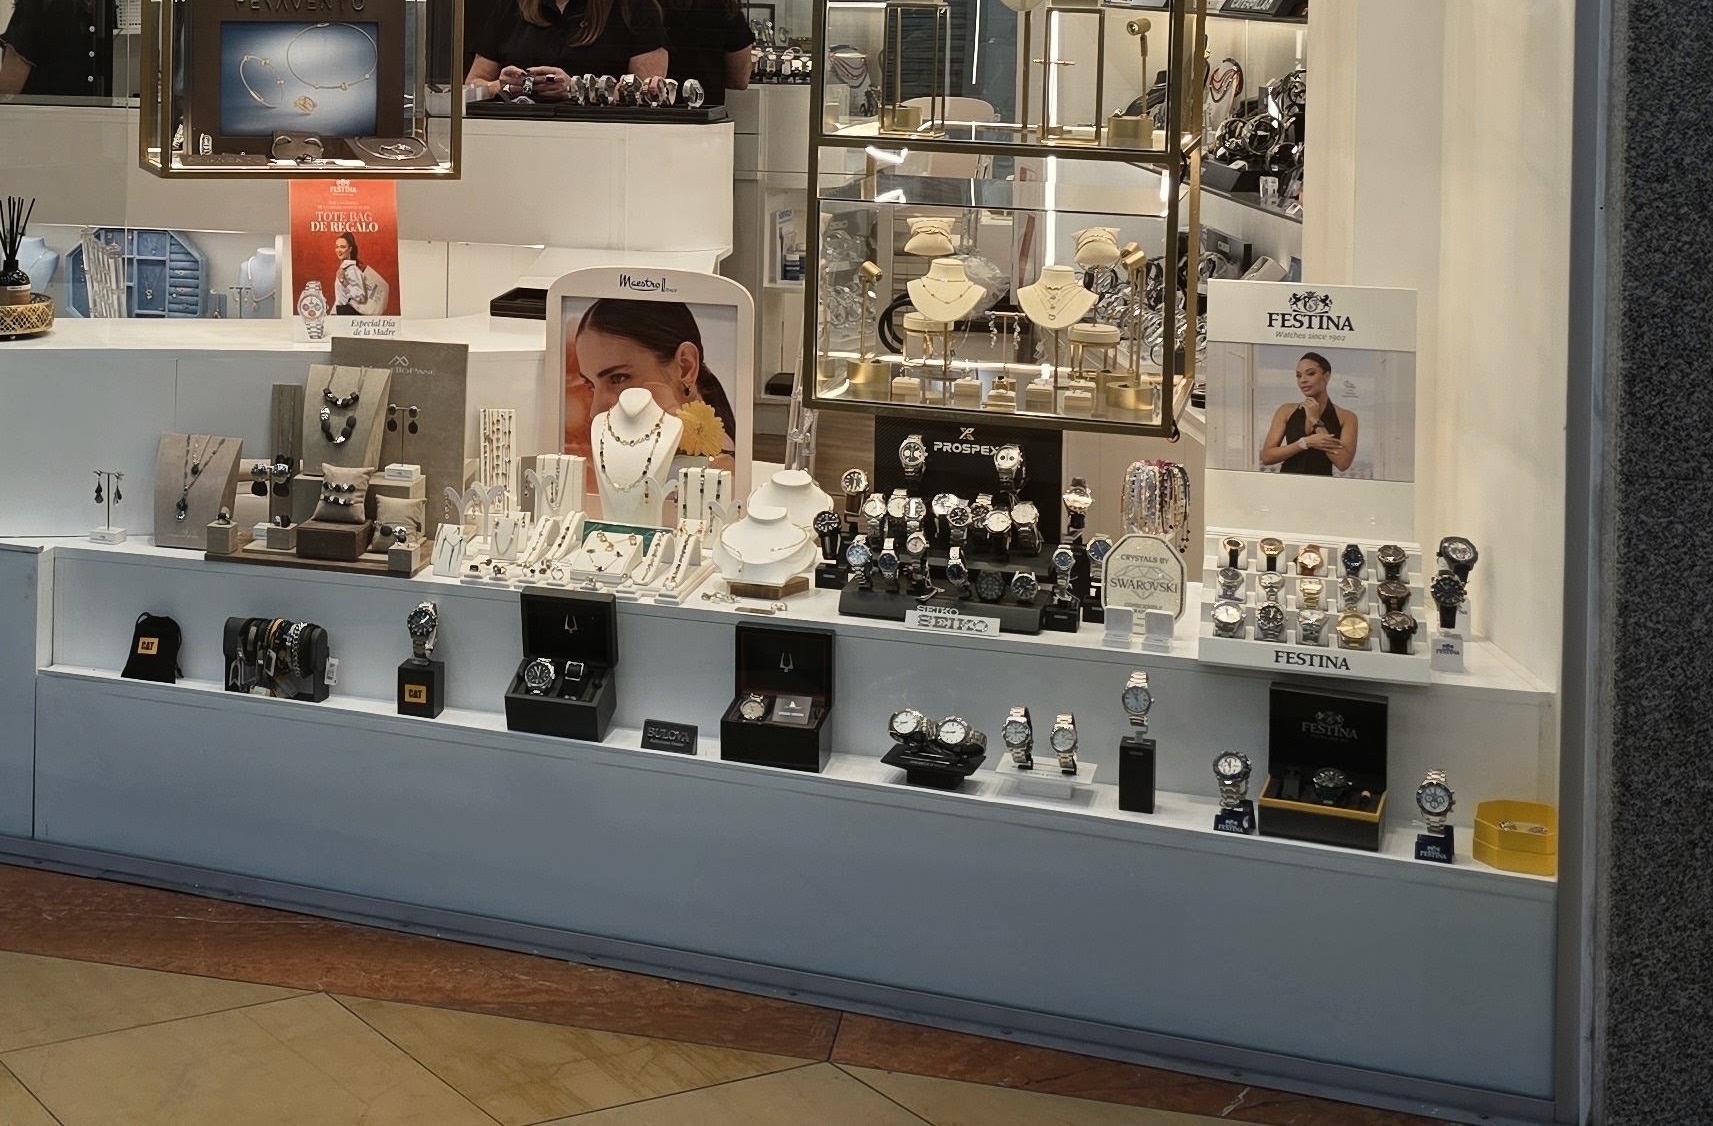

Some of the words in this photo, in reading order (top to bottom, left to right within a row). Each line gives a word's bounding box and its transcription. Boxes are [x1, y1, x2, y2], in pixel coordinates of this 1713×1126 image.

[330, 185, 357, 193] FESTINA
[316, 211, 346, 222] TOTE
[349, 212, 372, 222] BAG
[310, 221, 327, 232] DE
[330, 221, 378, 232] REGALO
[619, 273, 661, 291] Maestro
[351, 319, 381, 328] Especial
[382, 319, 395, 327] Día
[1267, 312, 1355, 331] FESTINA
[1275, 331, 1306, 339] Watches
[933, 441, 999, 455] PROSPEX
[1120, 554, 1158, 563] CRYSTALS
[1110, 577, 1178, 594] SWAROVSKI
[917, 605, 959, 615] SEIKO
[917, 614, 988, 632] SEIKO
[141, 640, 155, 650] CAT
[1274, 650, 1351, 670] FESTINA
[409, 689, 423, 698] CAT
[647, 727, 690, 742] BULOVA
[1302, 722, 1358, 739] FESTINA
[1218, 823, 1244, 833] FESTINA
[1419, 850, 1447, 860] FESTINA
